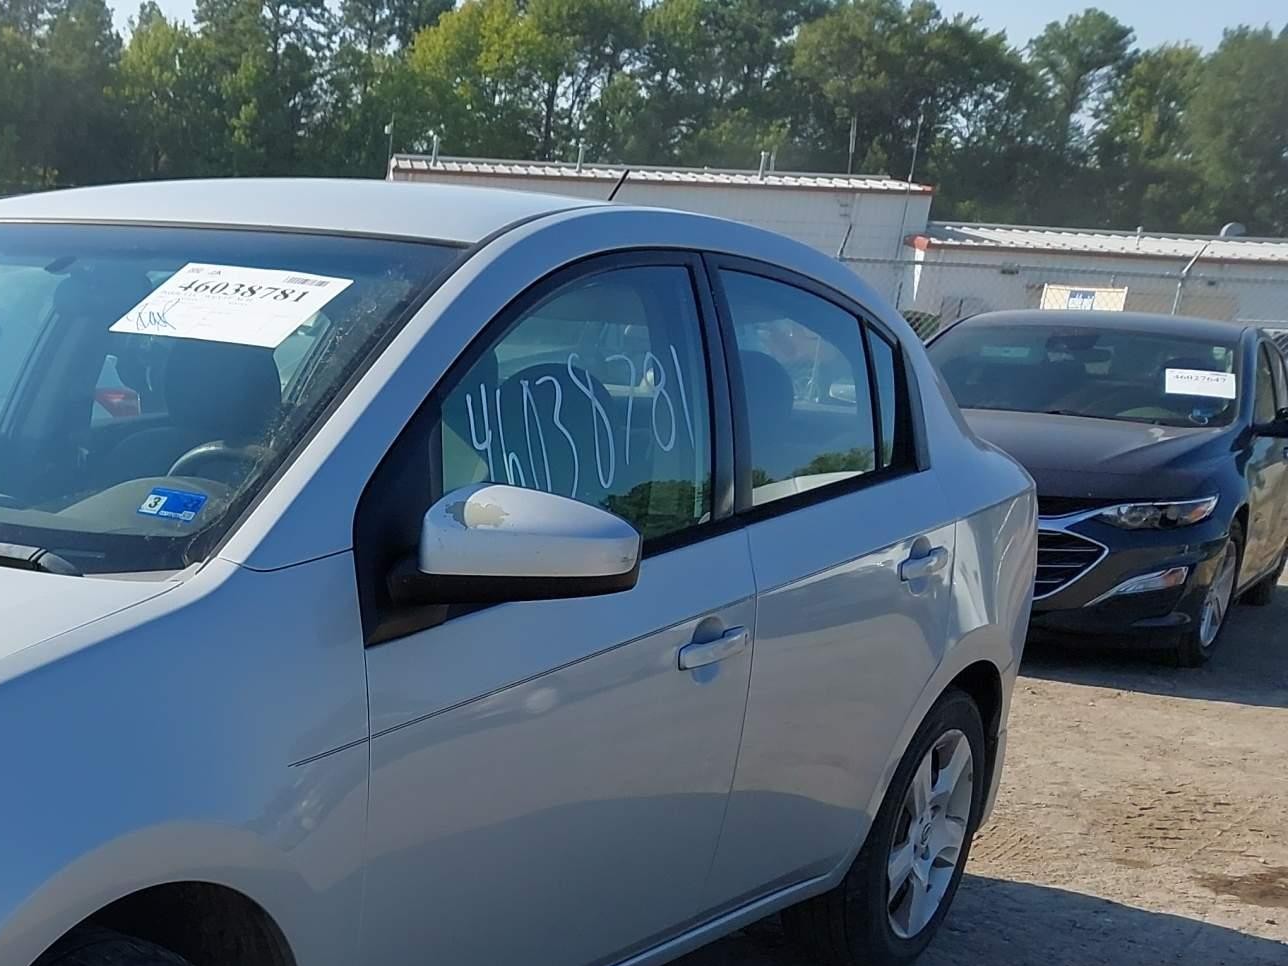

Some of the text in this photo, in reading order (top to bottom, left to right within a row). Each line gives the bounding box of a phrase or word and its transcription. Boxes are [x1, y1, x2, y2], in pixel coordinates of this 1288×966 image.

[178, 279, 311, 303] 46038781
[465, 344, 696, 499] 46038781
[148, 497, 162, 508] 3
